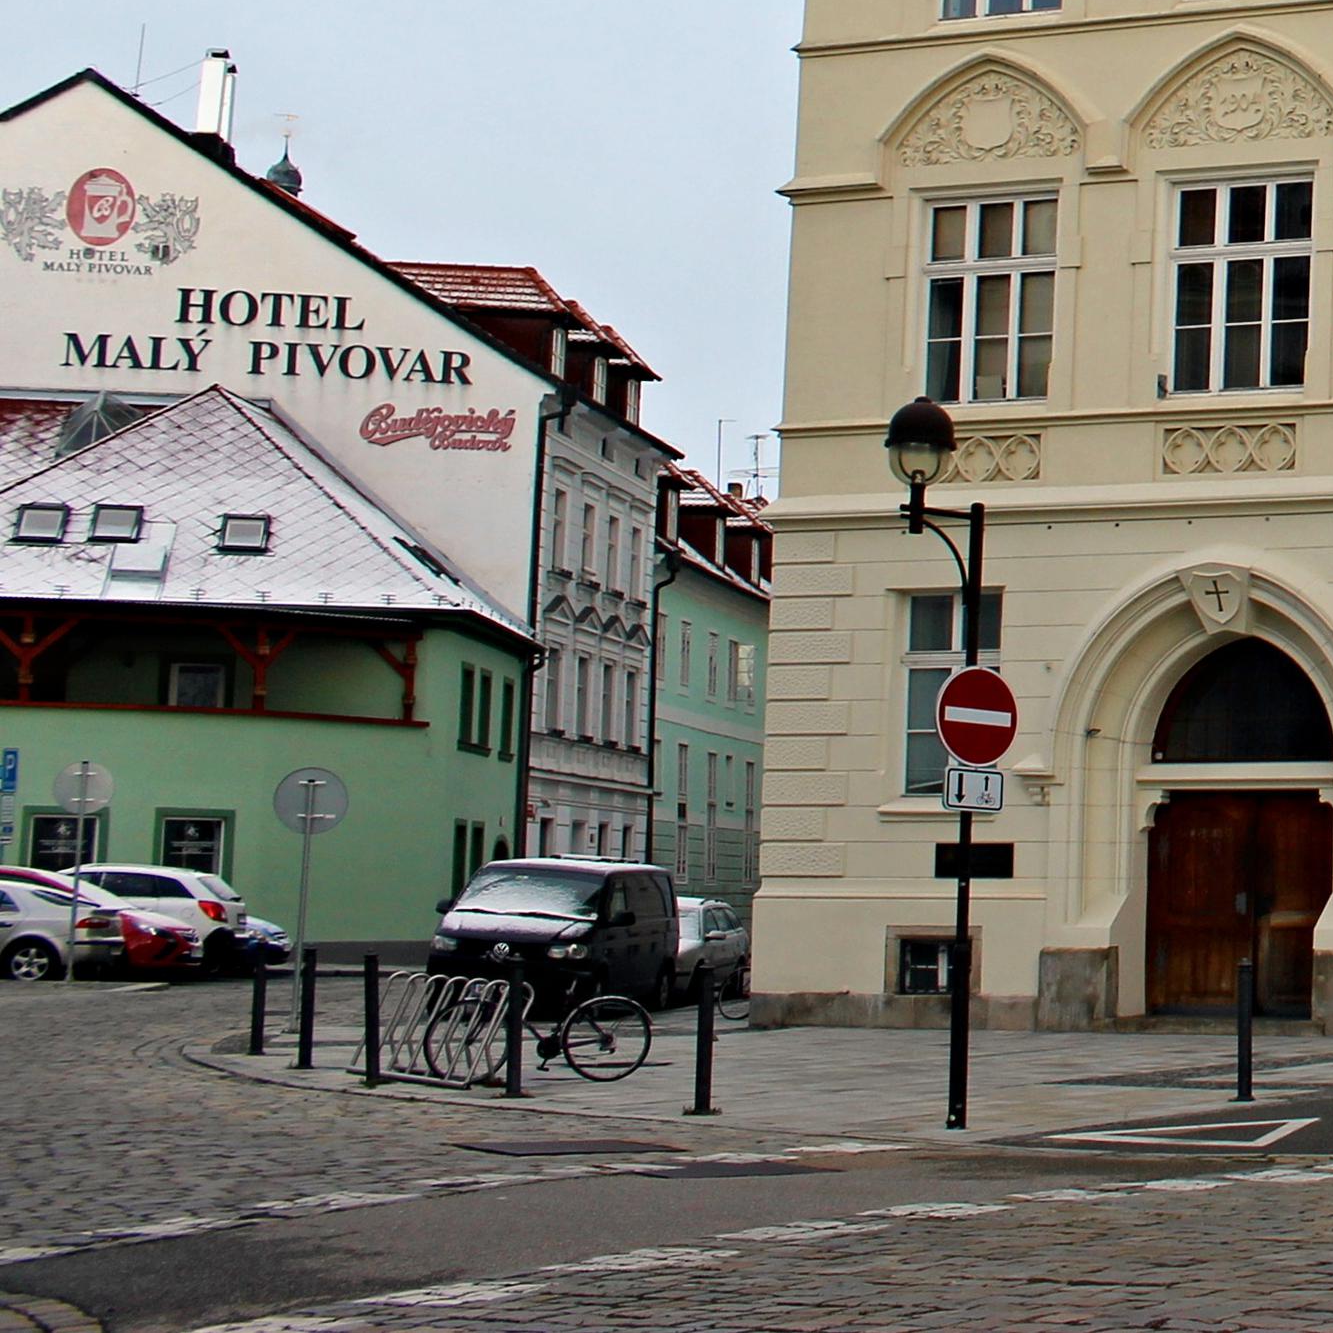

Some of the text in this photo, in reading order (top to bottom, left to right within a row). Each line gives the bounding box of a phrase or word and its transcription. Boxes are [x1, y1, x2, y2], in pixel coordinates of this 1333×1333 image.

[68, 247, 129, 262] HOTEL
[88, 263, 153, 275] PIVOVAR
[174, 287, 366, 331] HOTEL
[60, 328, 473, 385] MALÝ PIVOVAR
